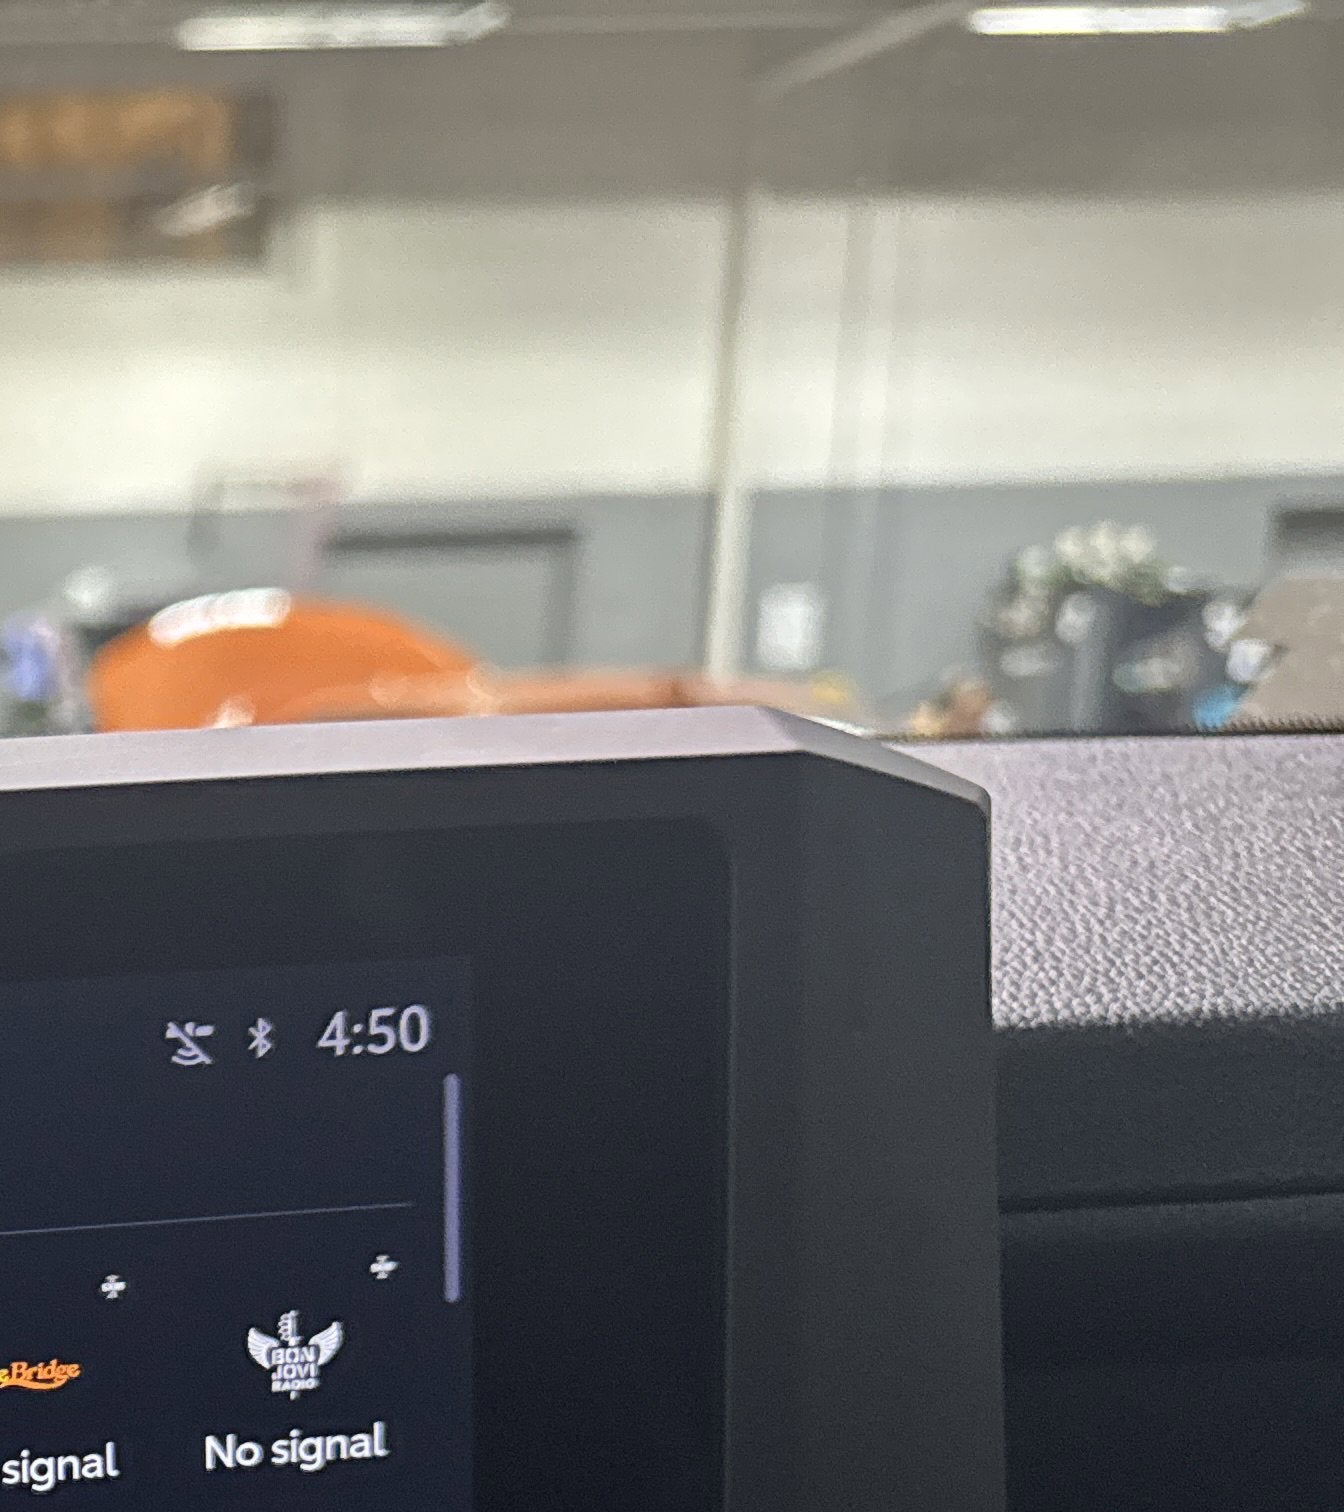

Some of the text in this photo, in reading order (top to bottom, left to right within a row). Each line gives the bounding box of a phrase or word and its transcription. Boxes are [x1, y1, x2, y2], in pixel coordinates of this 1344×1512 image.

[316, 1003, 431, 1057] 4:50
[271, 1346, 317, 1364] BON
[271, 1362, 320, 1381] JOVI
[270, 1378, 321, 1393] RADIO
[205, 1420, 391, 1473] No signal
[1, 1440, 120, 1492] signal
